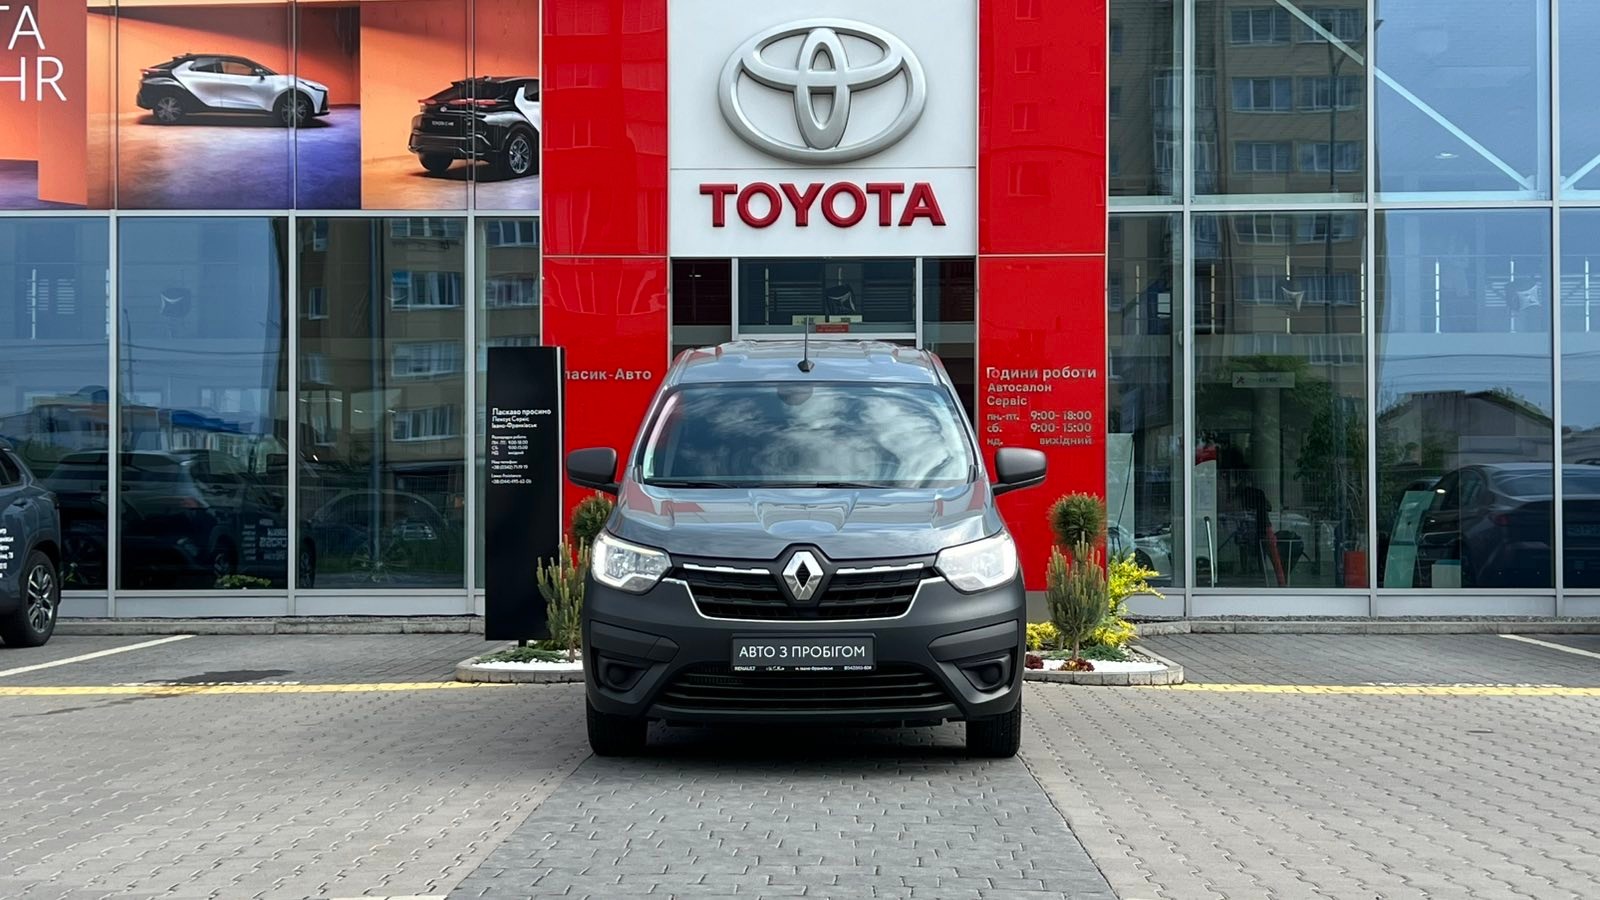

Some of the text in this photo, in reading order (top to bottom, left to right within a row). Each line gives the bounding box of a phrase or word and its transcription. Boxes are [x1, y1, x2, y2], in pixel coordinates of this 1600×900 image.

[0, 5, 46, 50] A
[699, 181, 946, 228] TOYOTA
[986, 366, 1097, 381] Години роботи
[987, 382, 1052, 392] Автосалон
[986, 395, 1028, 407] Сервіс
[1039, 435, 1093, 446] вихідний
[738, 645, 866, 658] АВТО З ПРОБІГОМ
